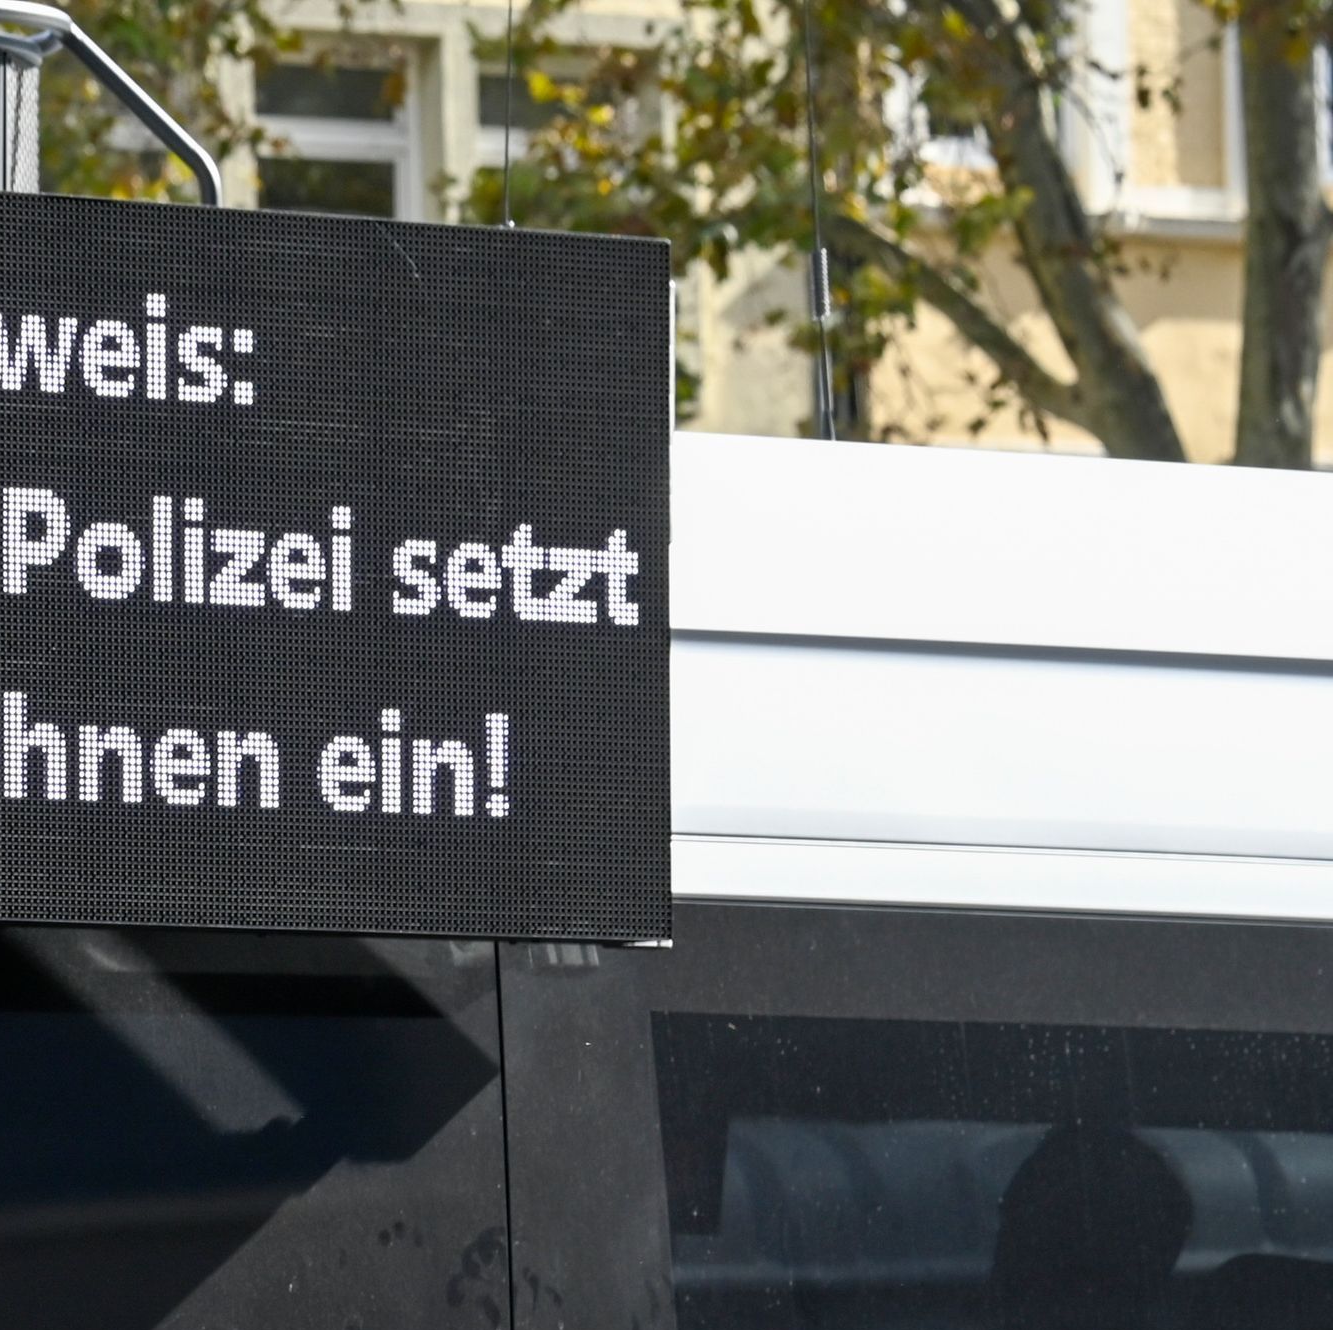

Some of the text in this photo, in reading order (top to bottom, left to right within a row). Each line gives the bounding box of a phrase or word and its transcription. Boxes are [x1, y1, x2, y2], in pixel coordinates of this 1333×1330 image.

[2, 486, 352, 612] Polizei
[392, 523, 639, 626] setzt
[317, 709, 510, 817] ein!
